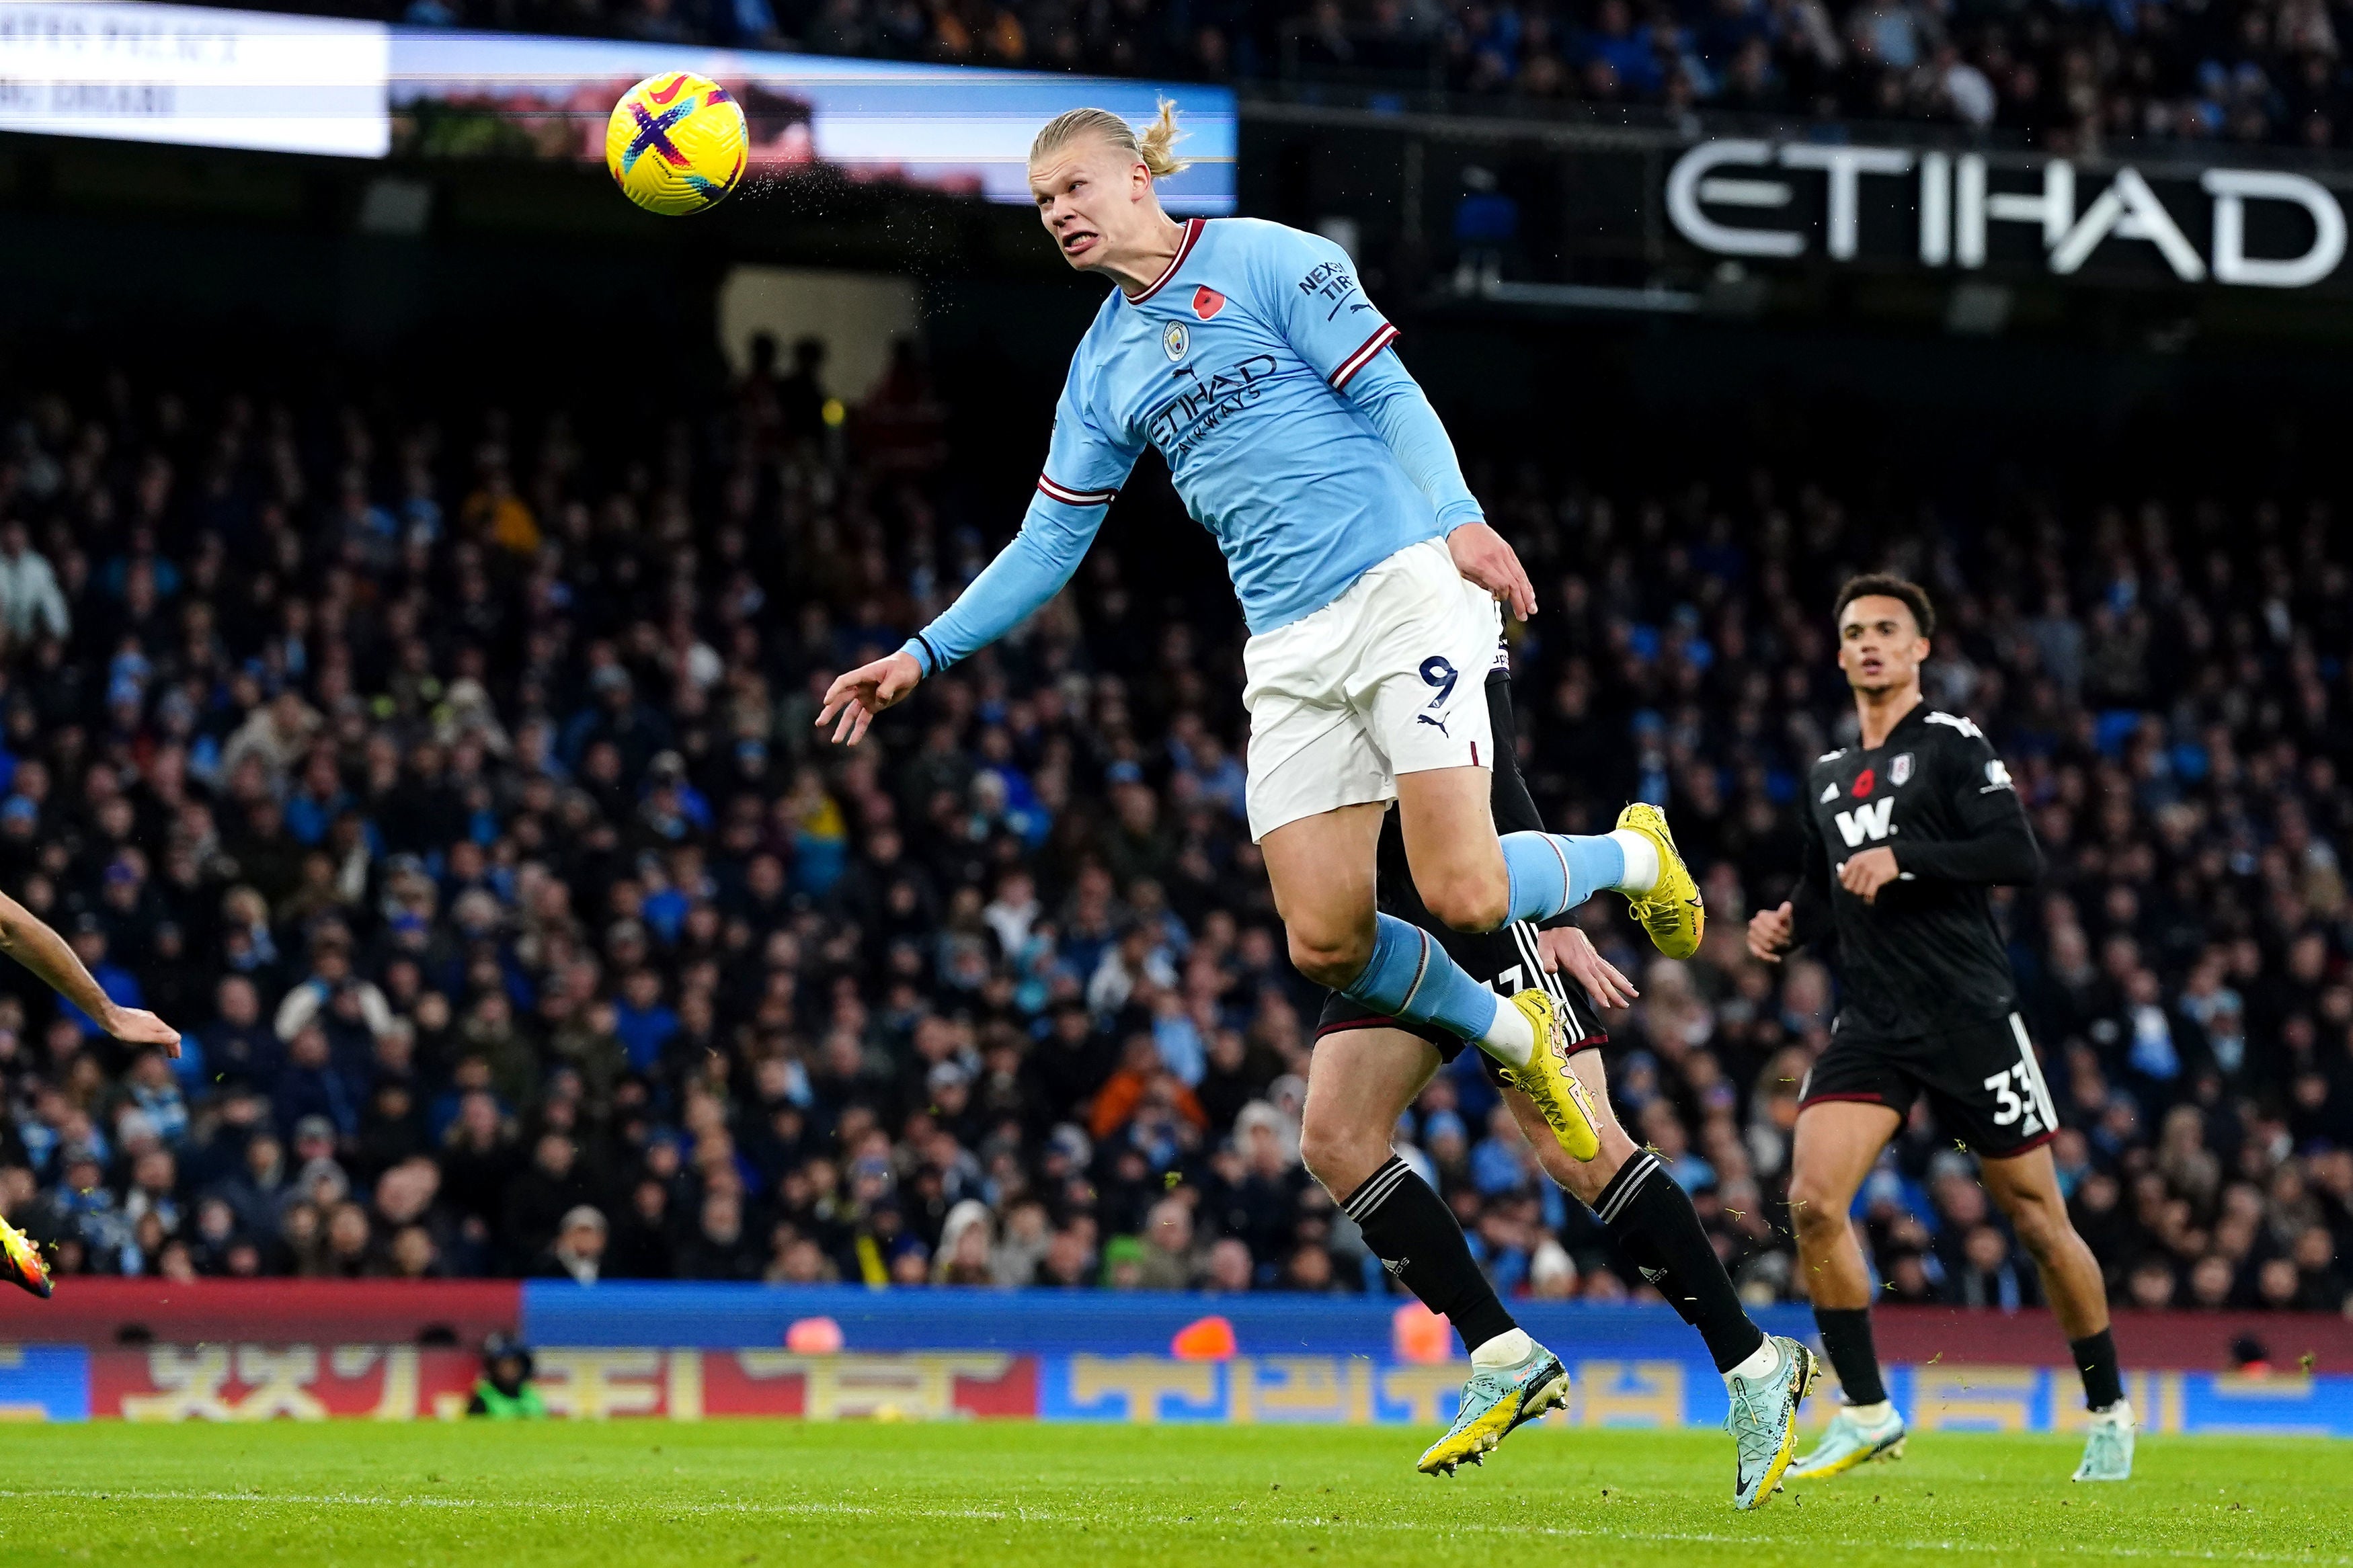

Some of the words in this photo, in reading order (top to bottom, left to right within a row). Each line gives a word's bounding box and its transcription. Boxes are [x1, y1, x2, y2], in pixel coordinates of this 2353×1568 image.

[1665, 139, 2349, 288] ETIHAD
[1150, 354, 1277, 446] ETIHAD
[1178, 384, 1261, 455] AIRWAYS
[1419, 655, 1458, 709] 9
